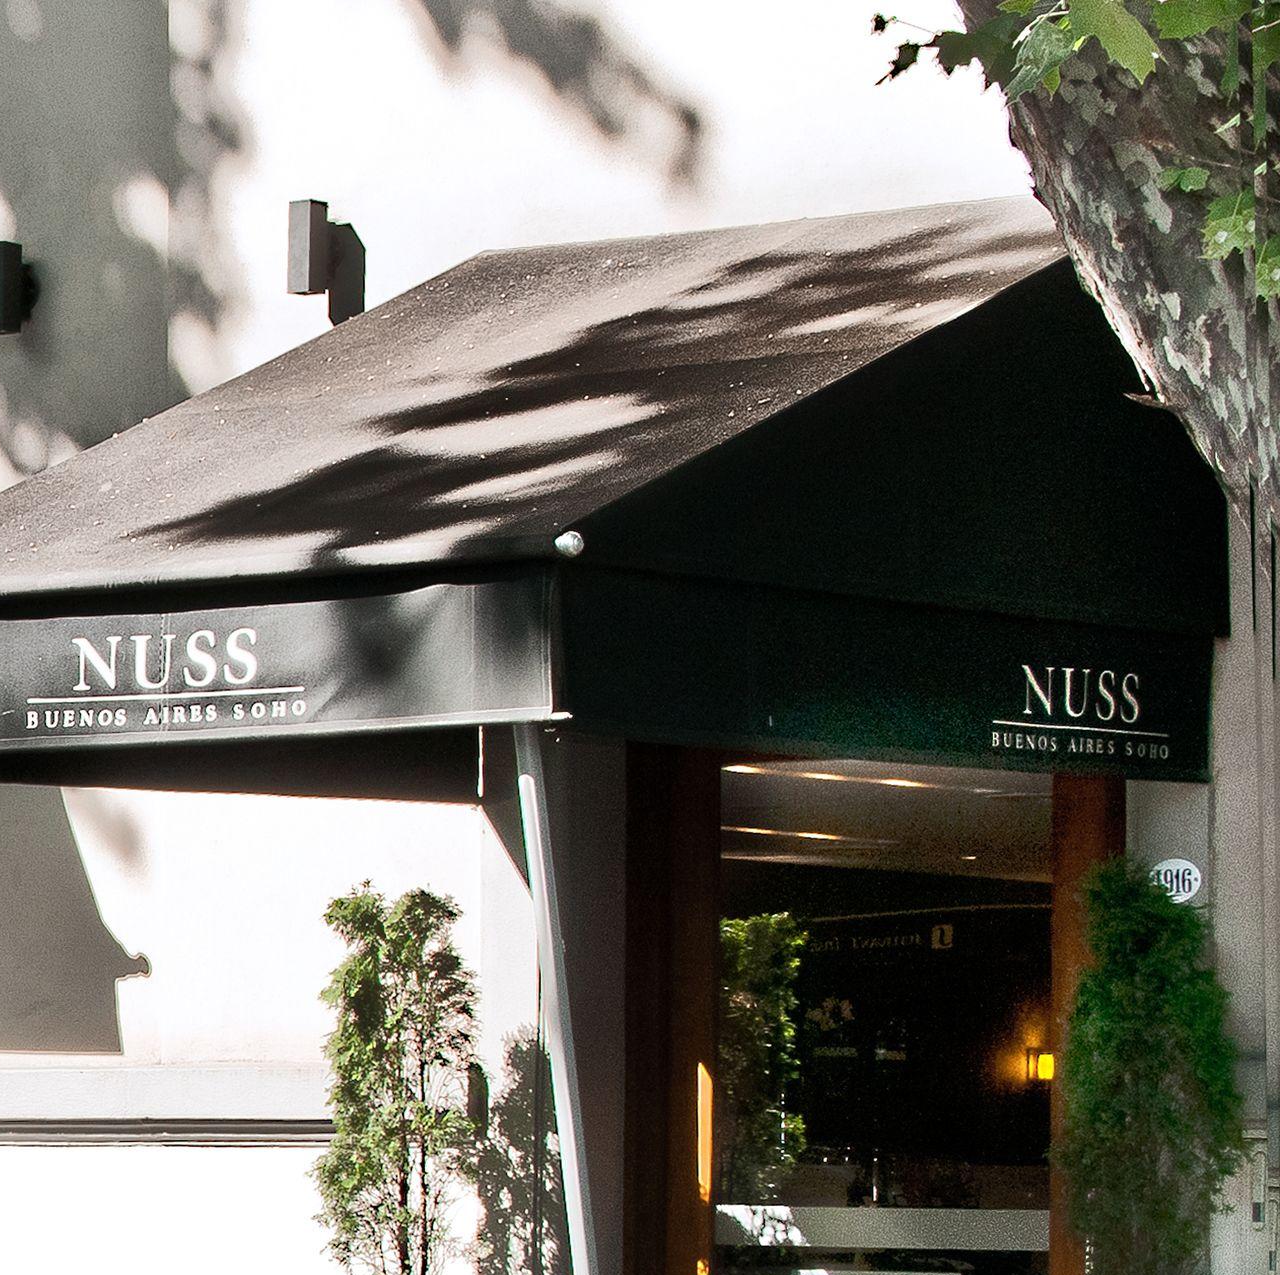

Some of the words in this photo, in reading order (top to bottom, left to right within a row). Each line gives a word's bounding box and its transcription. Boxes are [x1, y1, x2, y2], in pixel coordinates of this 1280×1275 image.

[71, 627, 258, 691] NUSS
[25, 708, 127, 730] BUENOS
[143, 703, 217, 726] AIRES
[232, 699, 306, 721] SOHO
[1021, 664, 1140, 723] NUSS
[991, 731, 1057, 751] BUENOS
[1067, 737, 1115, 755] AIRES
[1125, 741, 1169, 760] SOHO
